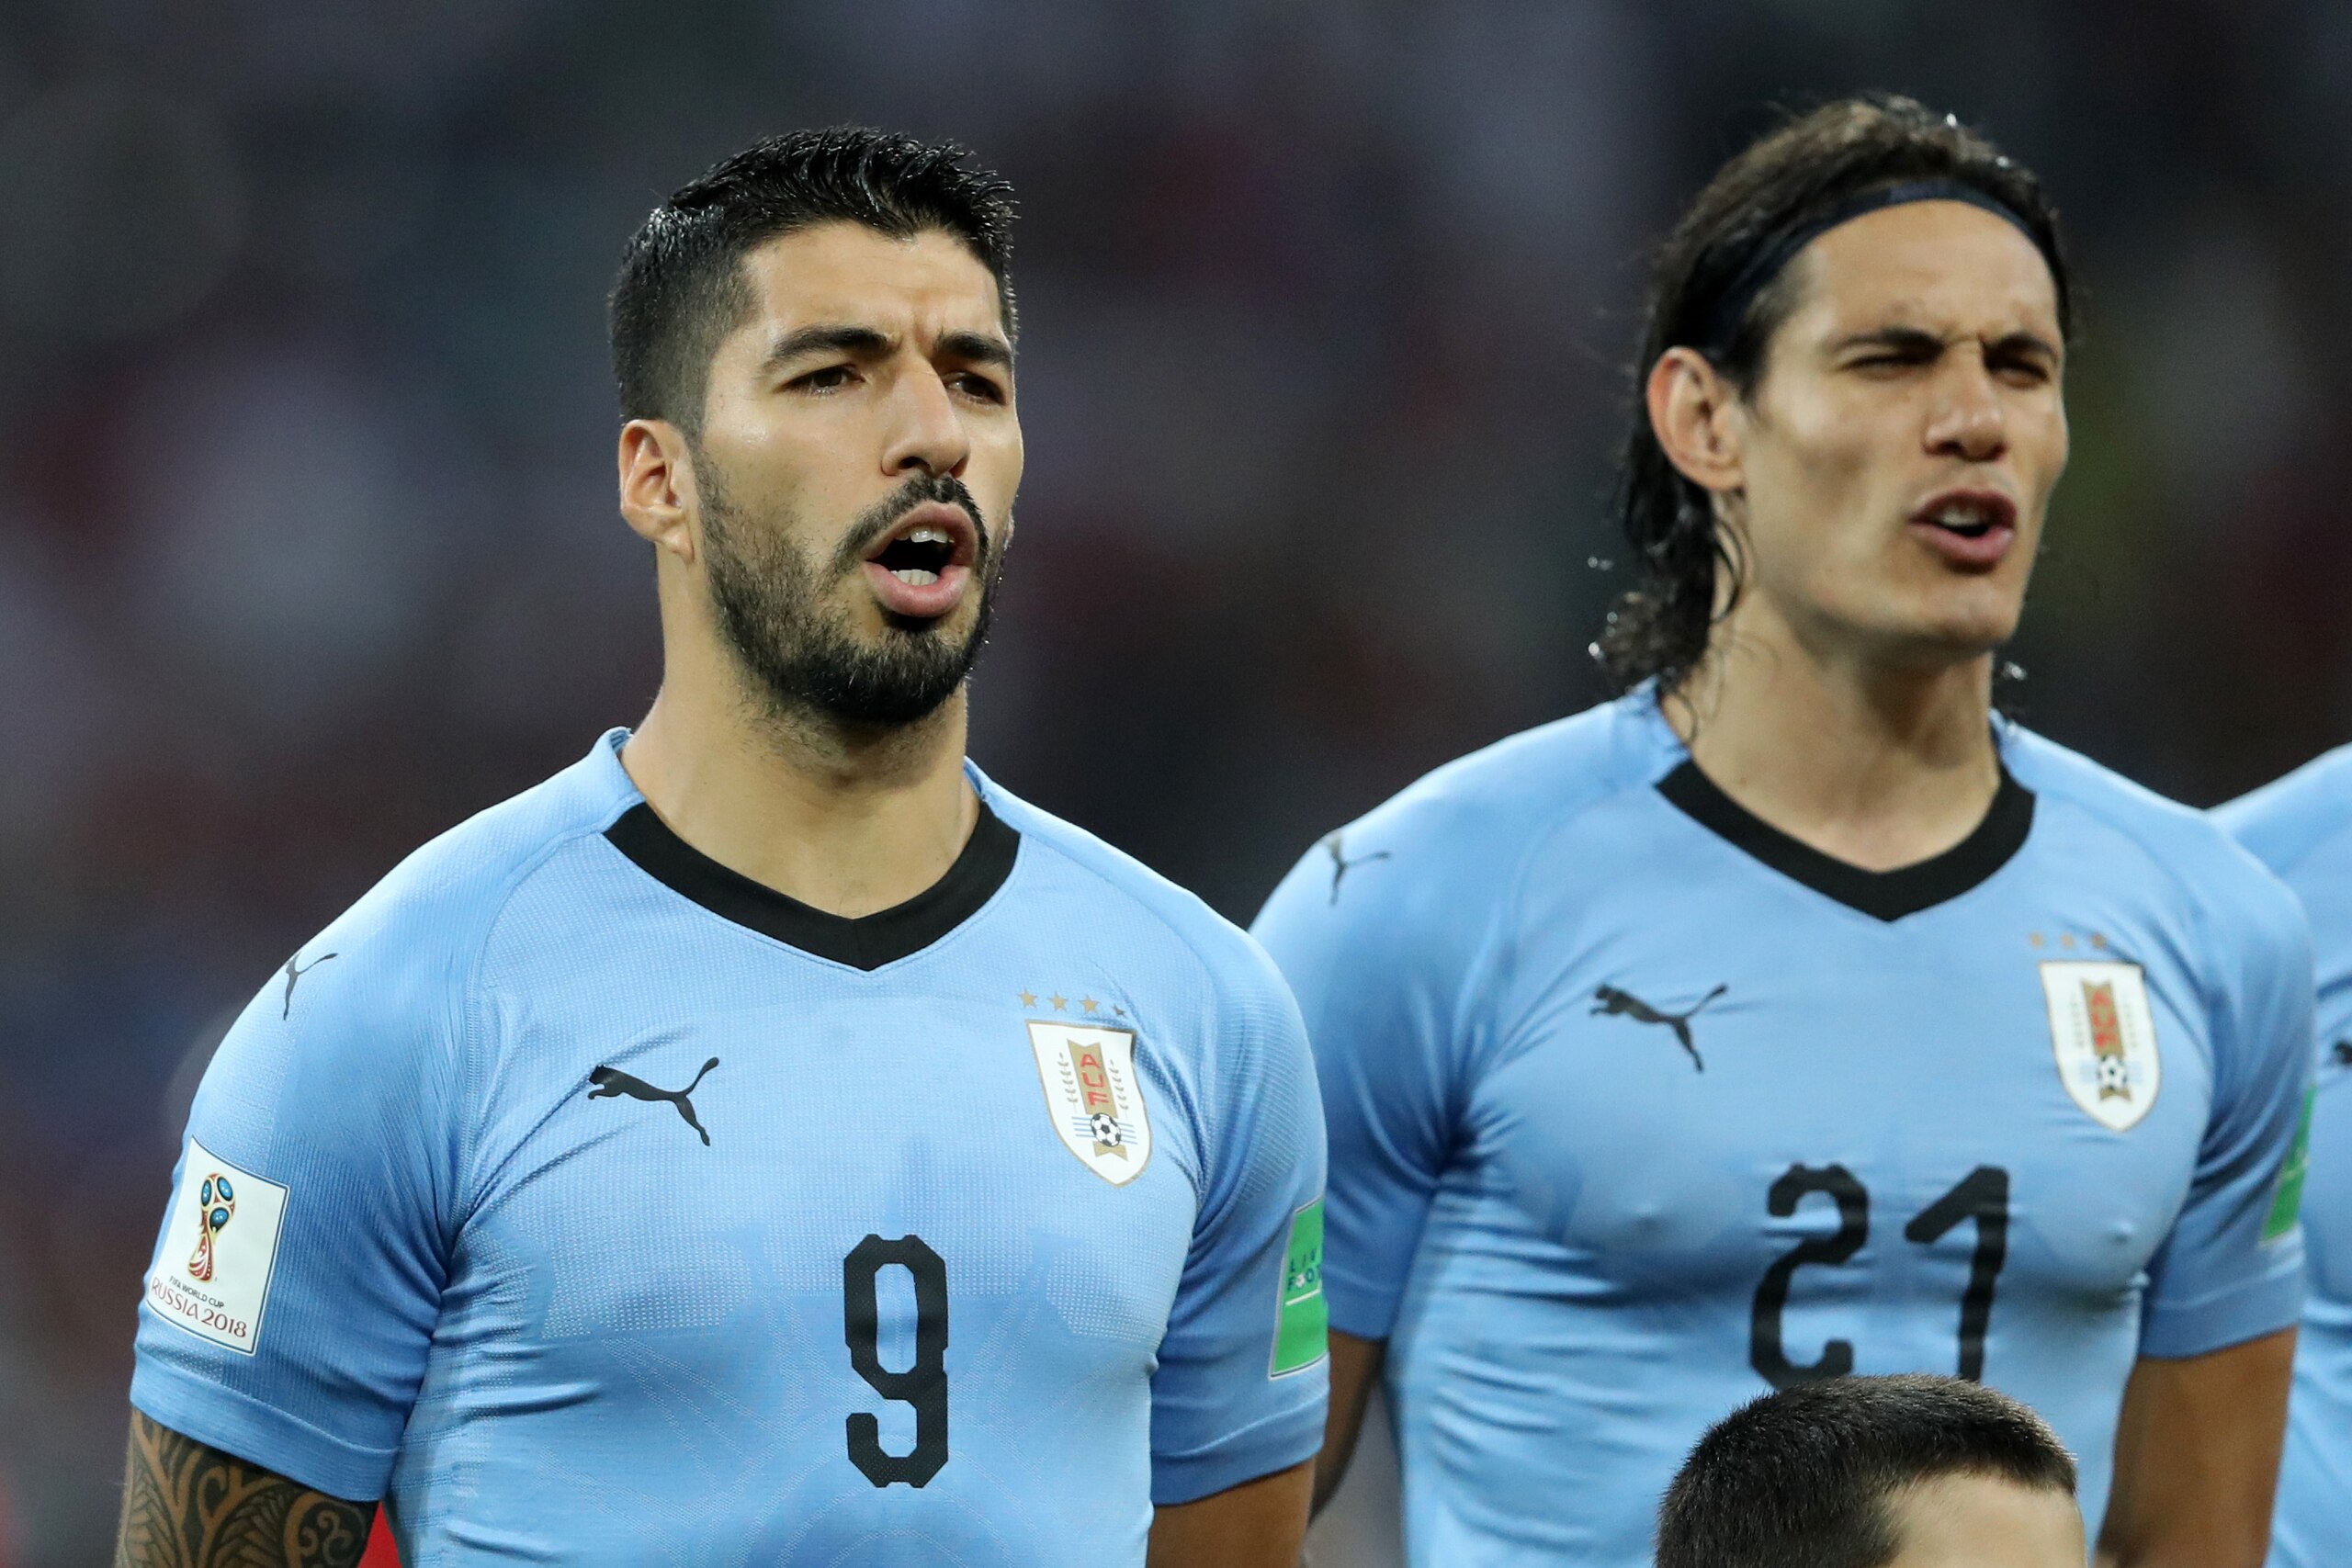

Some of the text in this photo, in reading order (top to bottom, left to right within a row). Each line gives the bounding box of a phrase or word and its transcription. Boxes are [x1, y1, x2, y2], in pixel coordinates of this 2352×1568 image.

[1080, 1054, 1109, 1106] AUF
[152, 1276, 247, 1338] RUSSIA 2018
[169, 1275, 225, 1309] FIFA WORLD CUP
[1749, 1161, 2009, 1391] 21
[843, 1234, 948, 1487] 9
